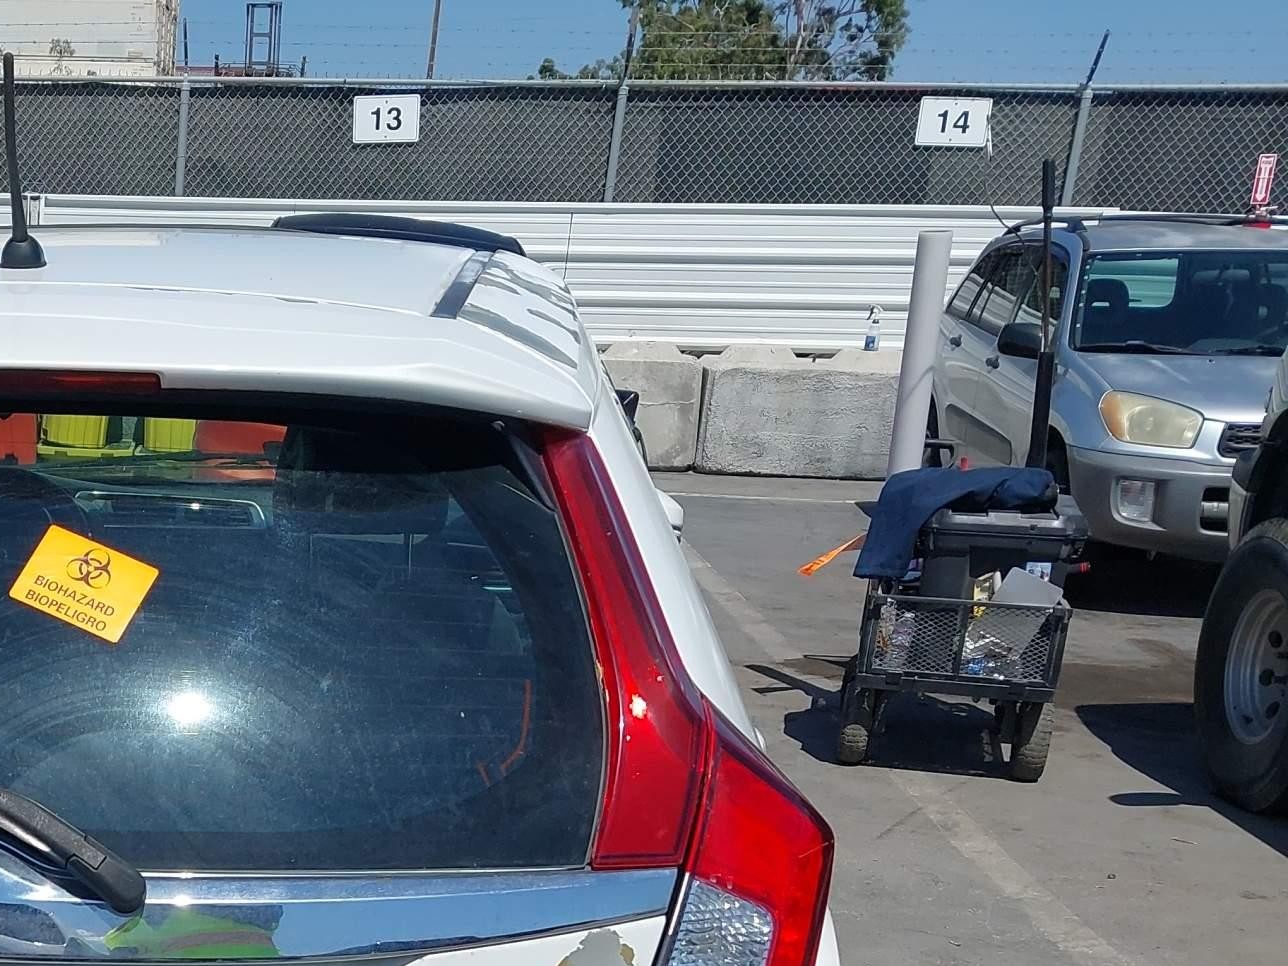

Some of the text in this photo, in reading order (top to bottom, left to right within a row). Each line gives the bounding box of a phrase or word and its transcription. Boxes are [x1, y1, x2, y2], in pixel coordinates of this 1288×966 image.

[370, 107, 402, 131] 13
[937, 109, 970, 134] 14
[25, 589, 107, 632] BIOPELIGRO
[34, 574, 115, 617] BIOHAZARD
